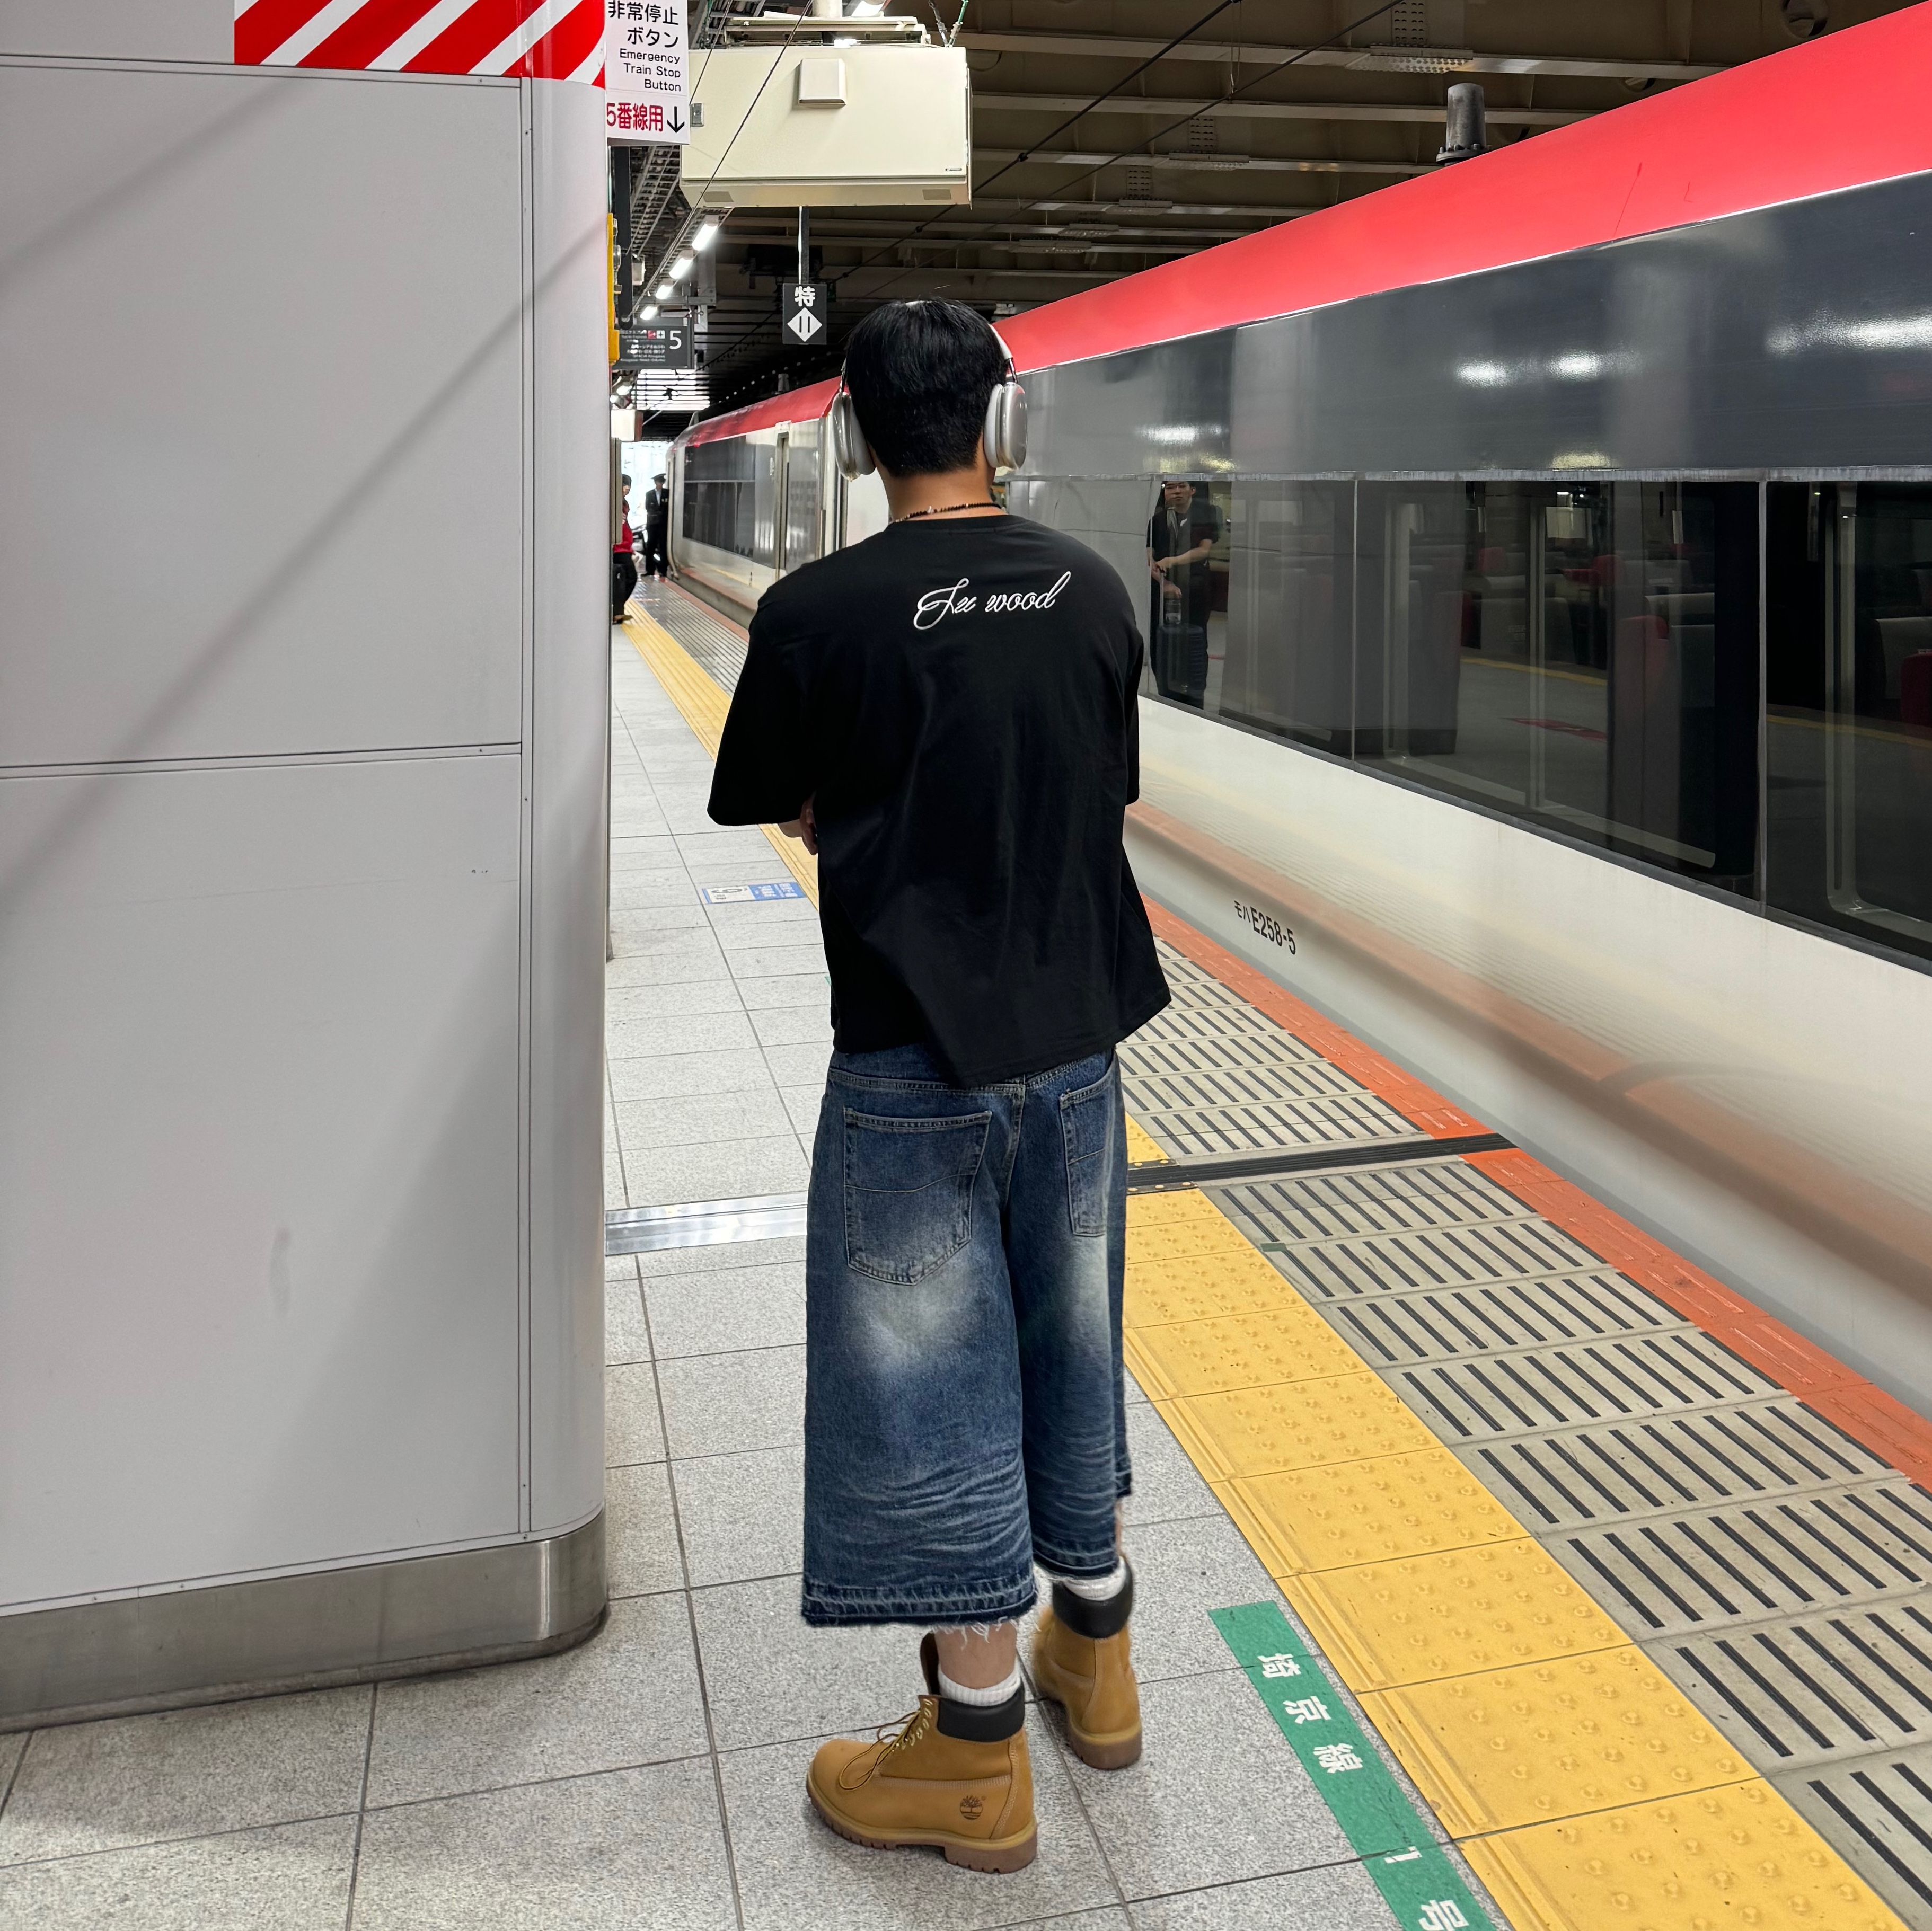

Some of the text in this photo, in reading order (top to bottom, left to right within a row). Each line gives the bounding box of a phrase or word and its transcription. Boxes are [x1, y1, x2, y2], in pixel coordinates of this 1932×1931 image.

[608, 1, 679, 25] 非常停止
[627, 27, 678, 48] ボタン
[620, 48, 680, 64] Emergency
[623, 63, 681, 78] Train Stop
[645, 79, 681, 92] Button
[606, 102, 664, 132] 5番線用
[794, 286, 816, 307] 特
[669, 330, 682, 350] 5
[984, 571, 1071, 613] wood
